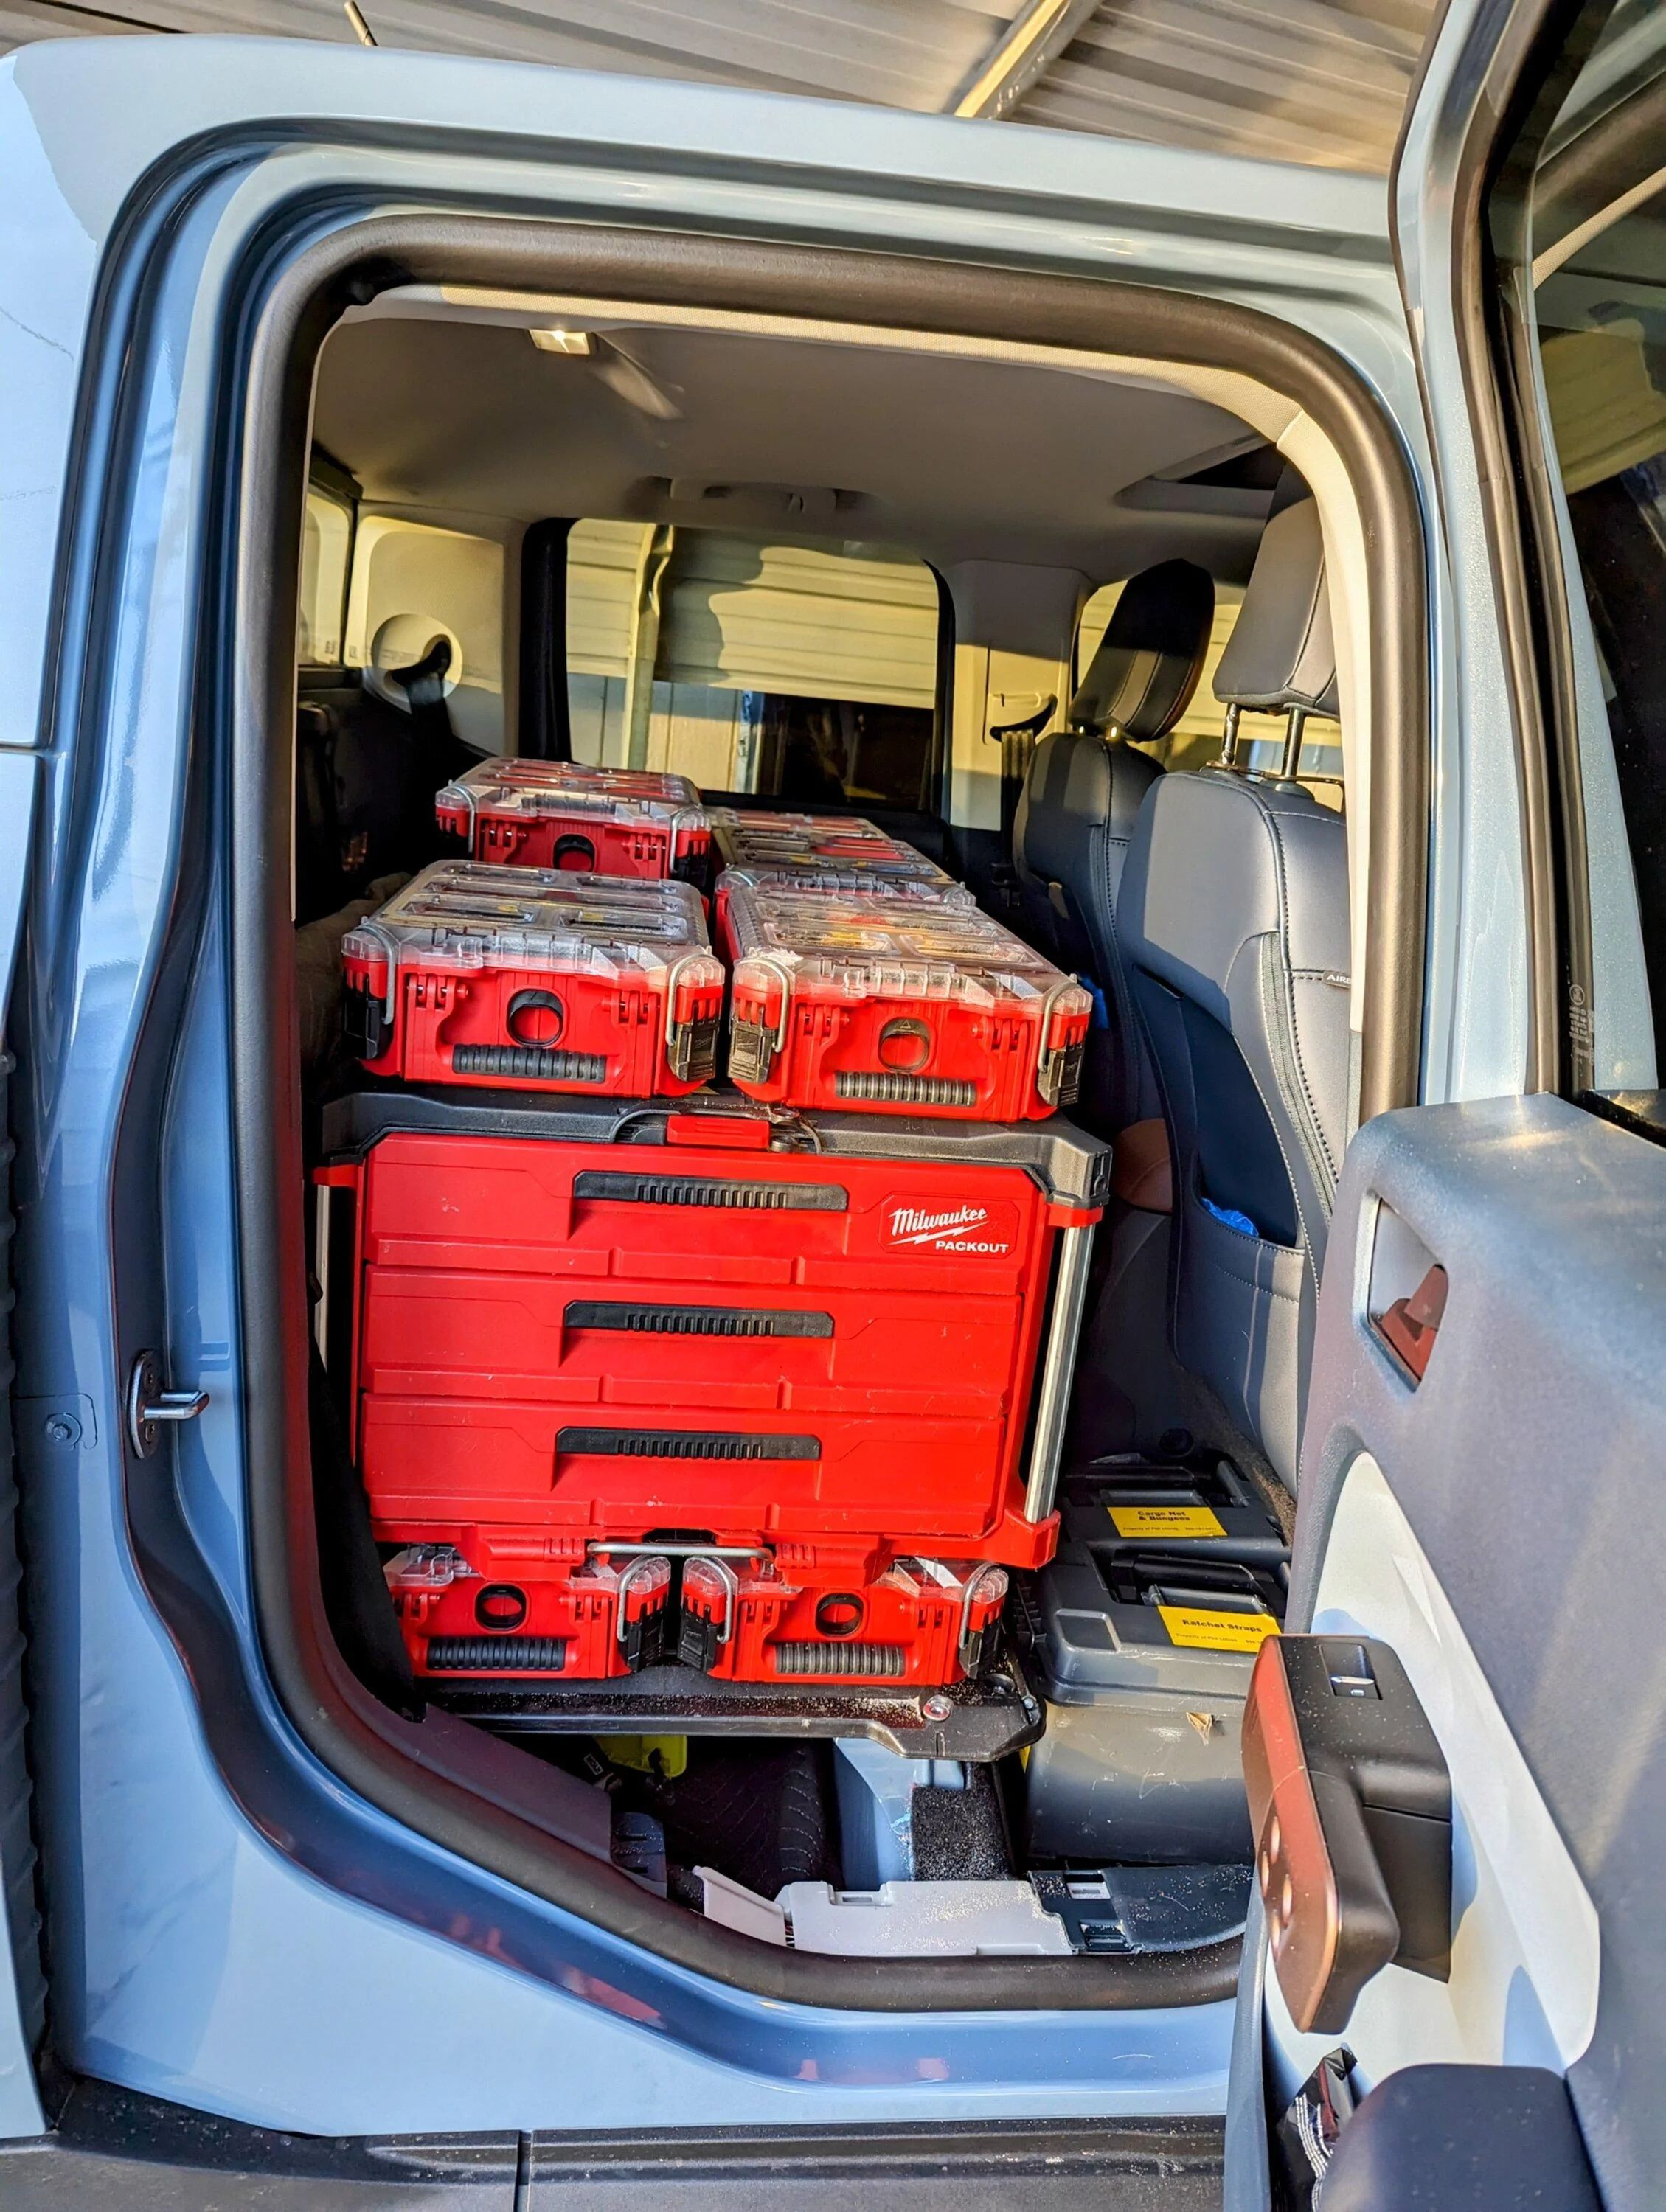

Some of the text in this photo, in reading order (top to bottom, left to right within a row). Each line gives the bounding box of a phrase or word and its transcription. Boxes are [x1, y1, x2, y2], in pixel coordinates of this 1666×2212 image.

[888, 1204, 988, 1237] Milwaukee
[935, 1241, 1009, 1253] PACKOUT
[1182, 1619, 1262, 1632] Ratchet Straps
